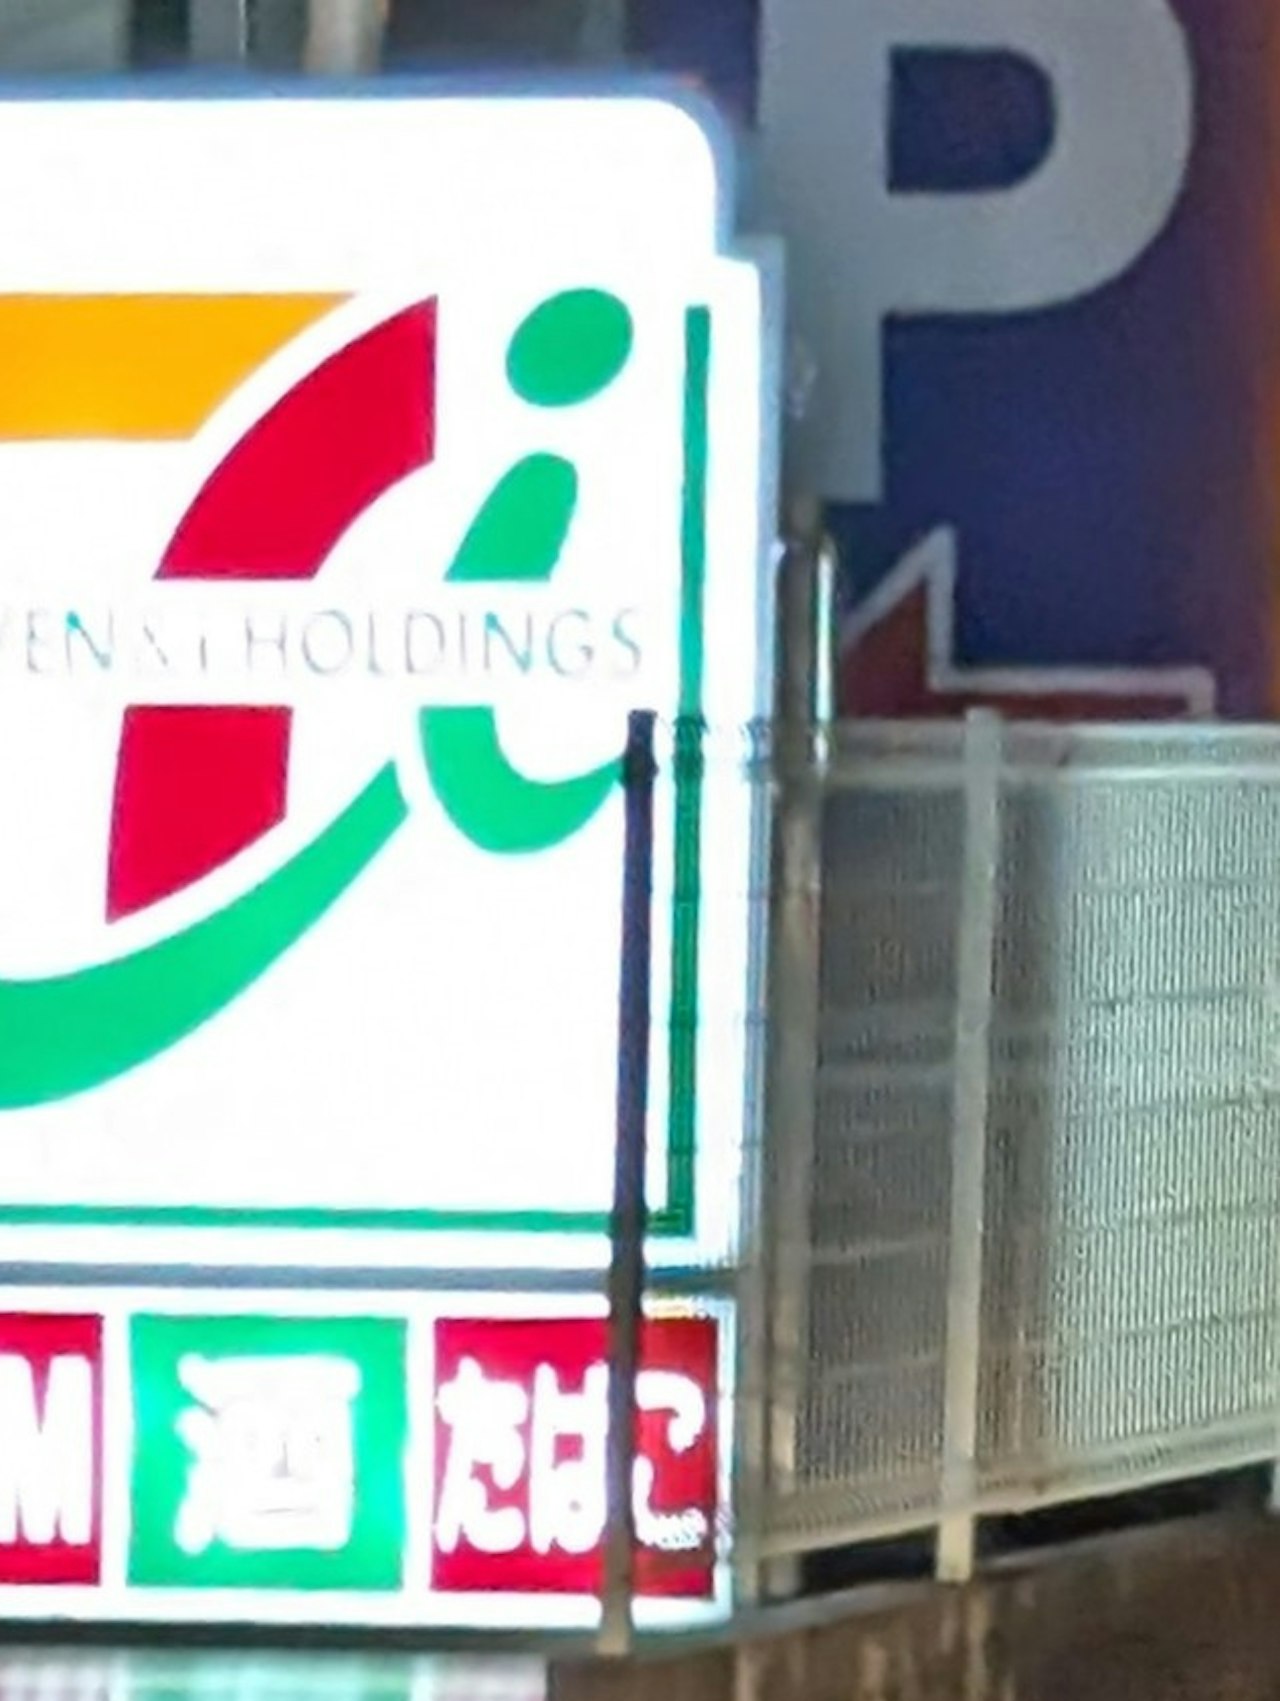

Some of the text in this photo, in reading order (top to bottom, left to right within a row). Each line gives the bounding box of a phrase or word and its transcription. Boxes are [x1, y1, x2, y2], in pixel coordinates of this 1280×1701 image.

[758, 0, 1195, 503] P
[244, 607, 643, 678] HOLDINGS
[172, 1353, 362, 1556] 酒
